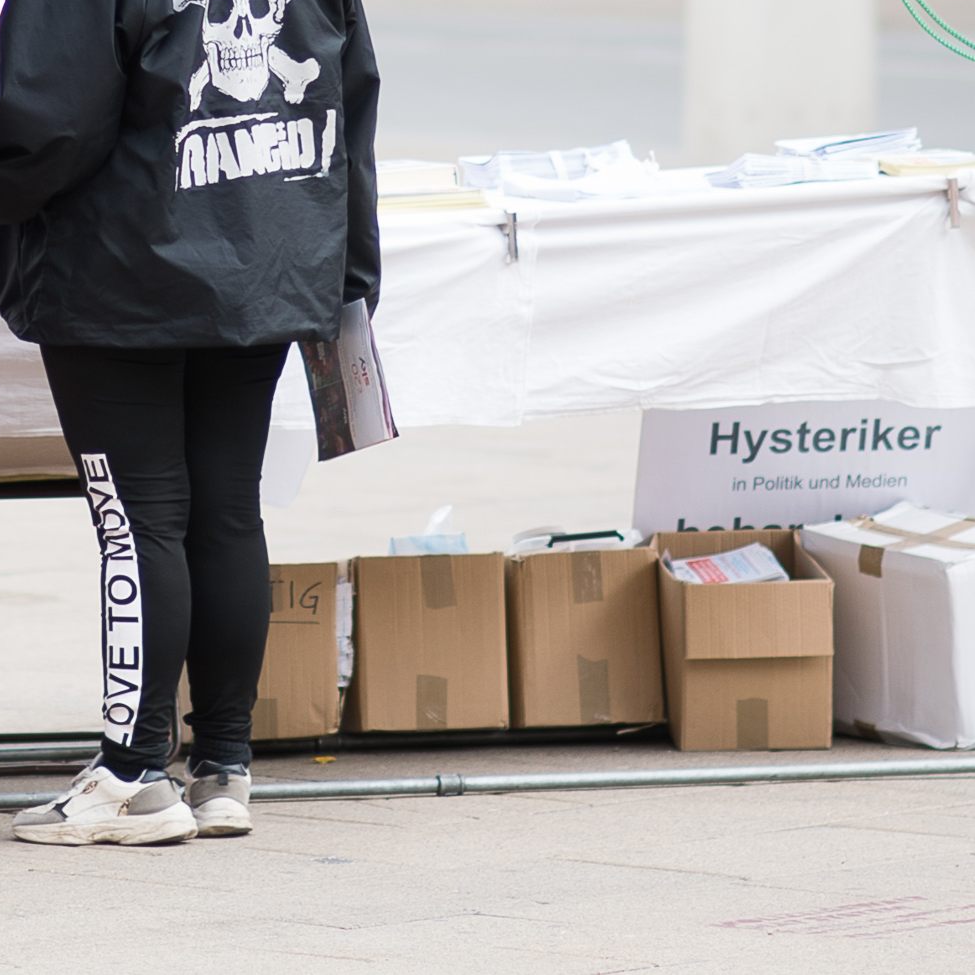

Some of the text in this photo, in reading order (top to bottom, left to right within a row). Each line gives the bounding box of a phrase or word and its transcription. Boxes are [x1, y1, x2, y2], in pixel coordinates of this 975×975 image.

[709, 418, 942, 464] Hysteriker
[83, 458, 134, 560] MOVE
[732, 474, 908, 492] in Politik und Medien
[107, 574, 139, 632] TO
